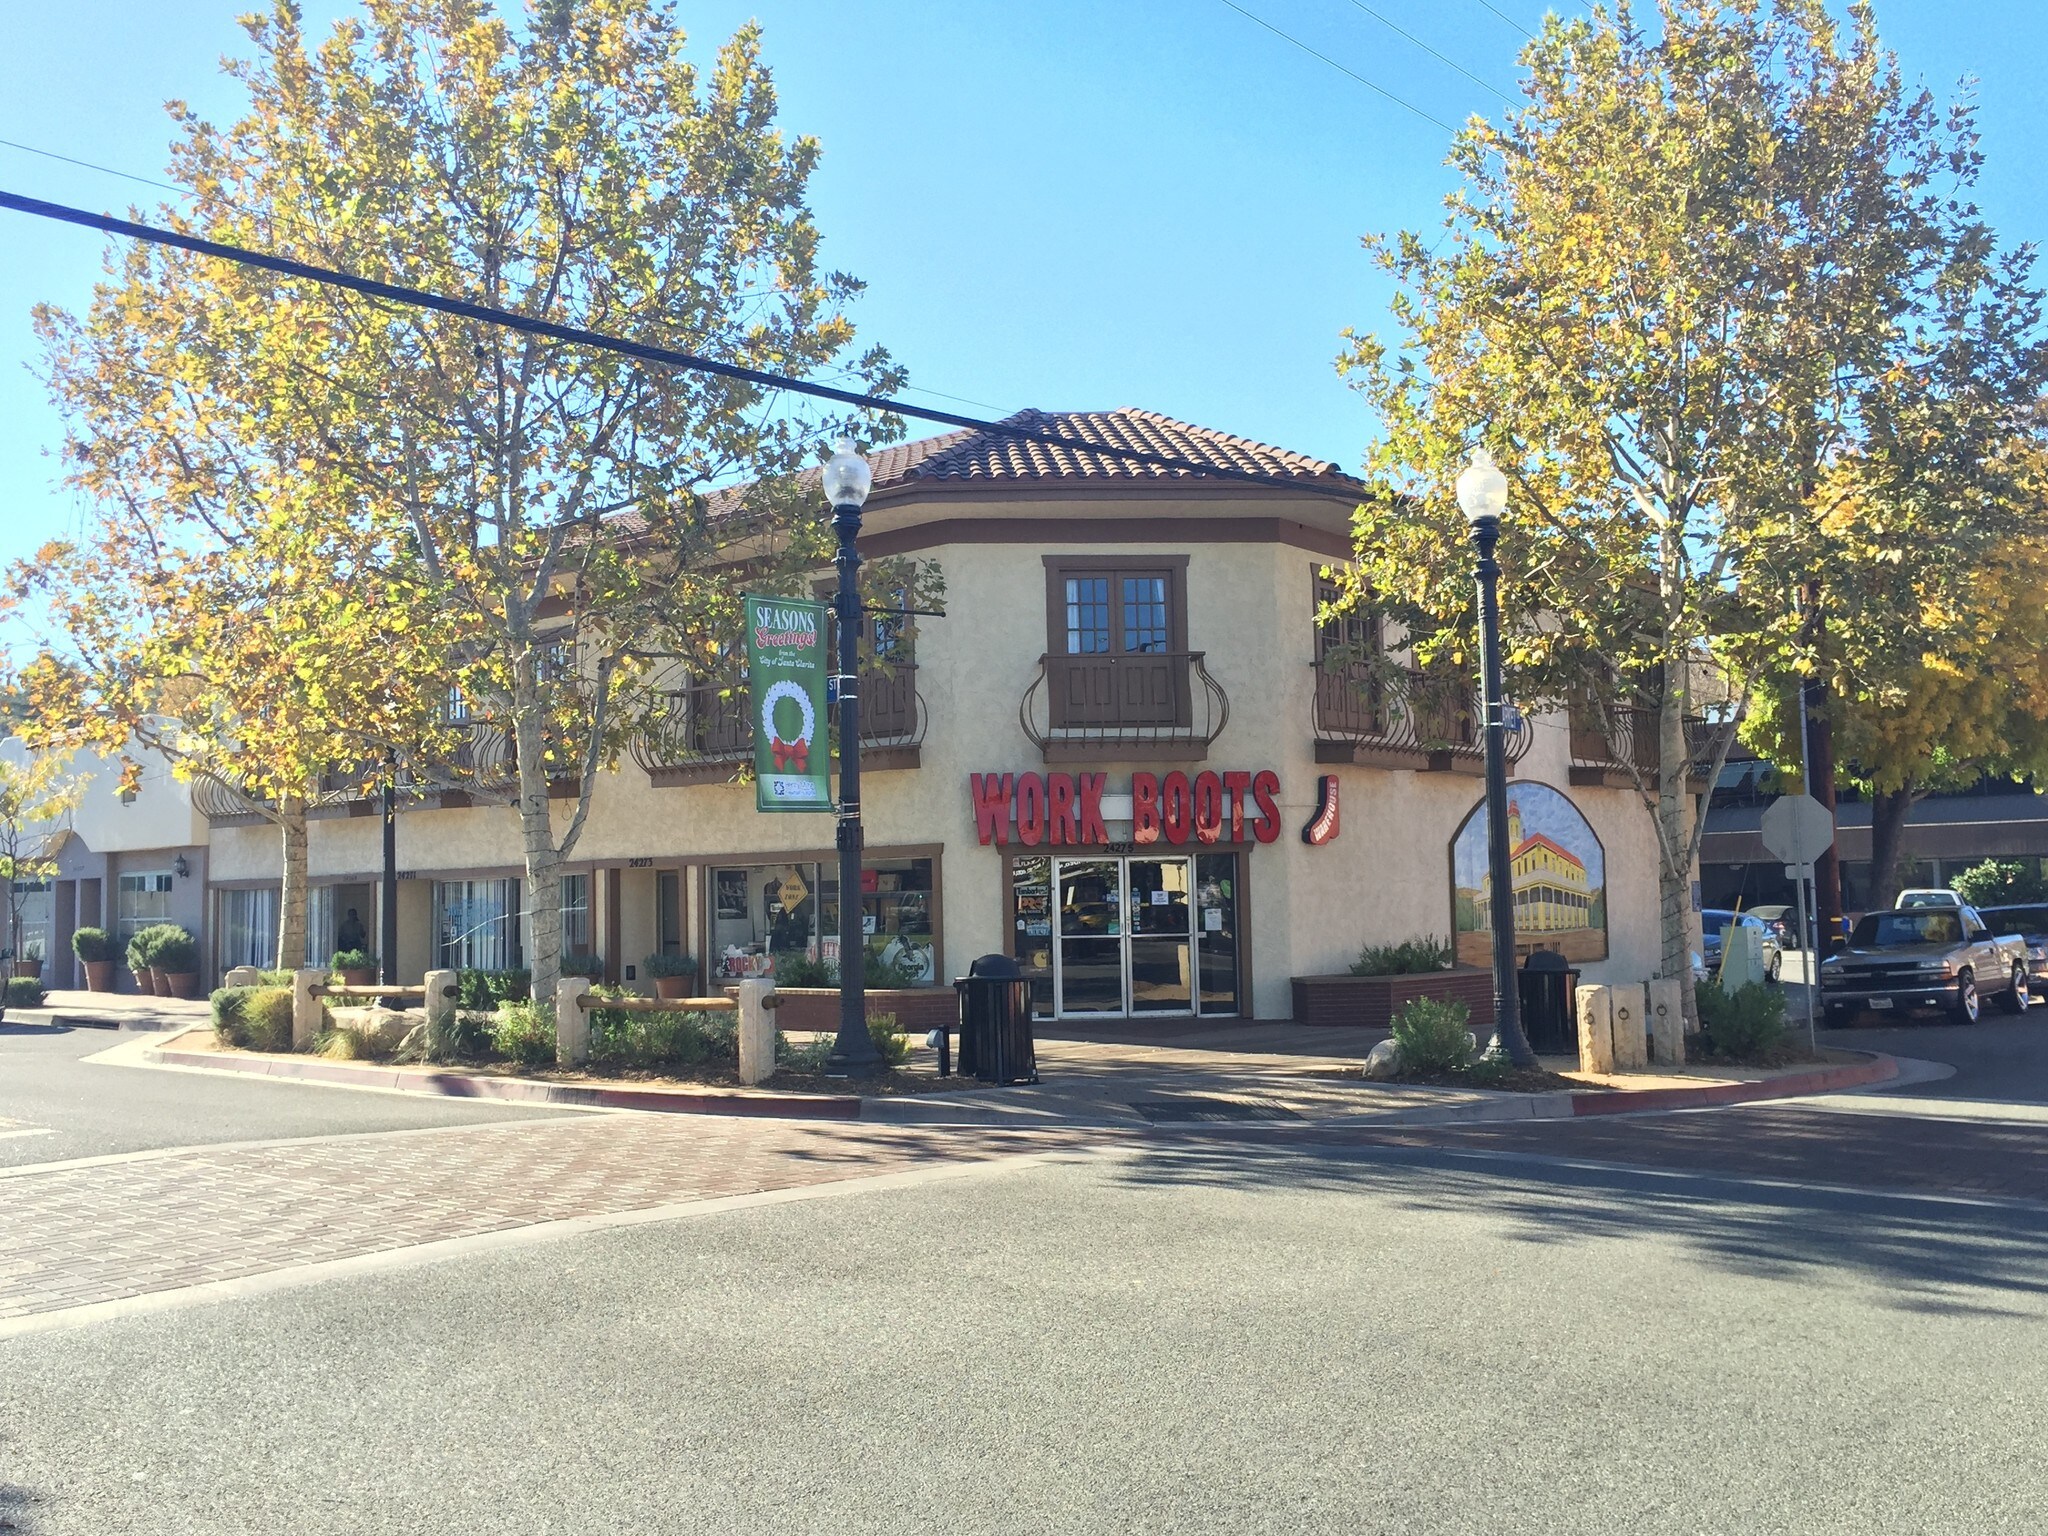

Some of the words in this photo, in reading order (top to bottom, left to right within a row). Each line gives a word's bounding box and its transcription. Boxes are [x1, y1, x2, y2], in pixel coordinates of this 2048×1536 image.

[756, 606, 815, 633] SEASONS
[755, 626, 818, 651] Greetings!
[970, 772, 1109, 846] WORK
[1132, 770, 1281, 845] BOOTS
[1313, 781, 1338, 842] WAREHOUSE
[1103, 843, 1134, 853] 24275
